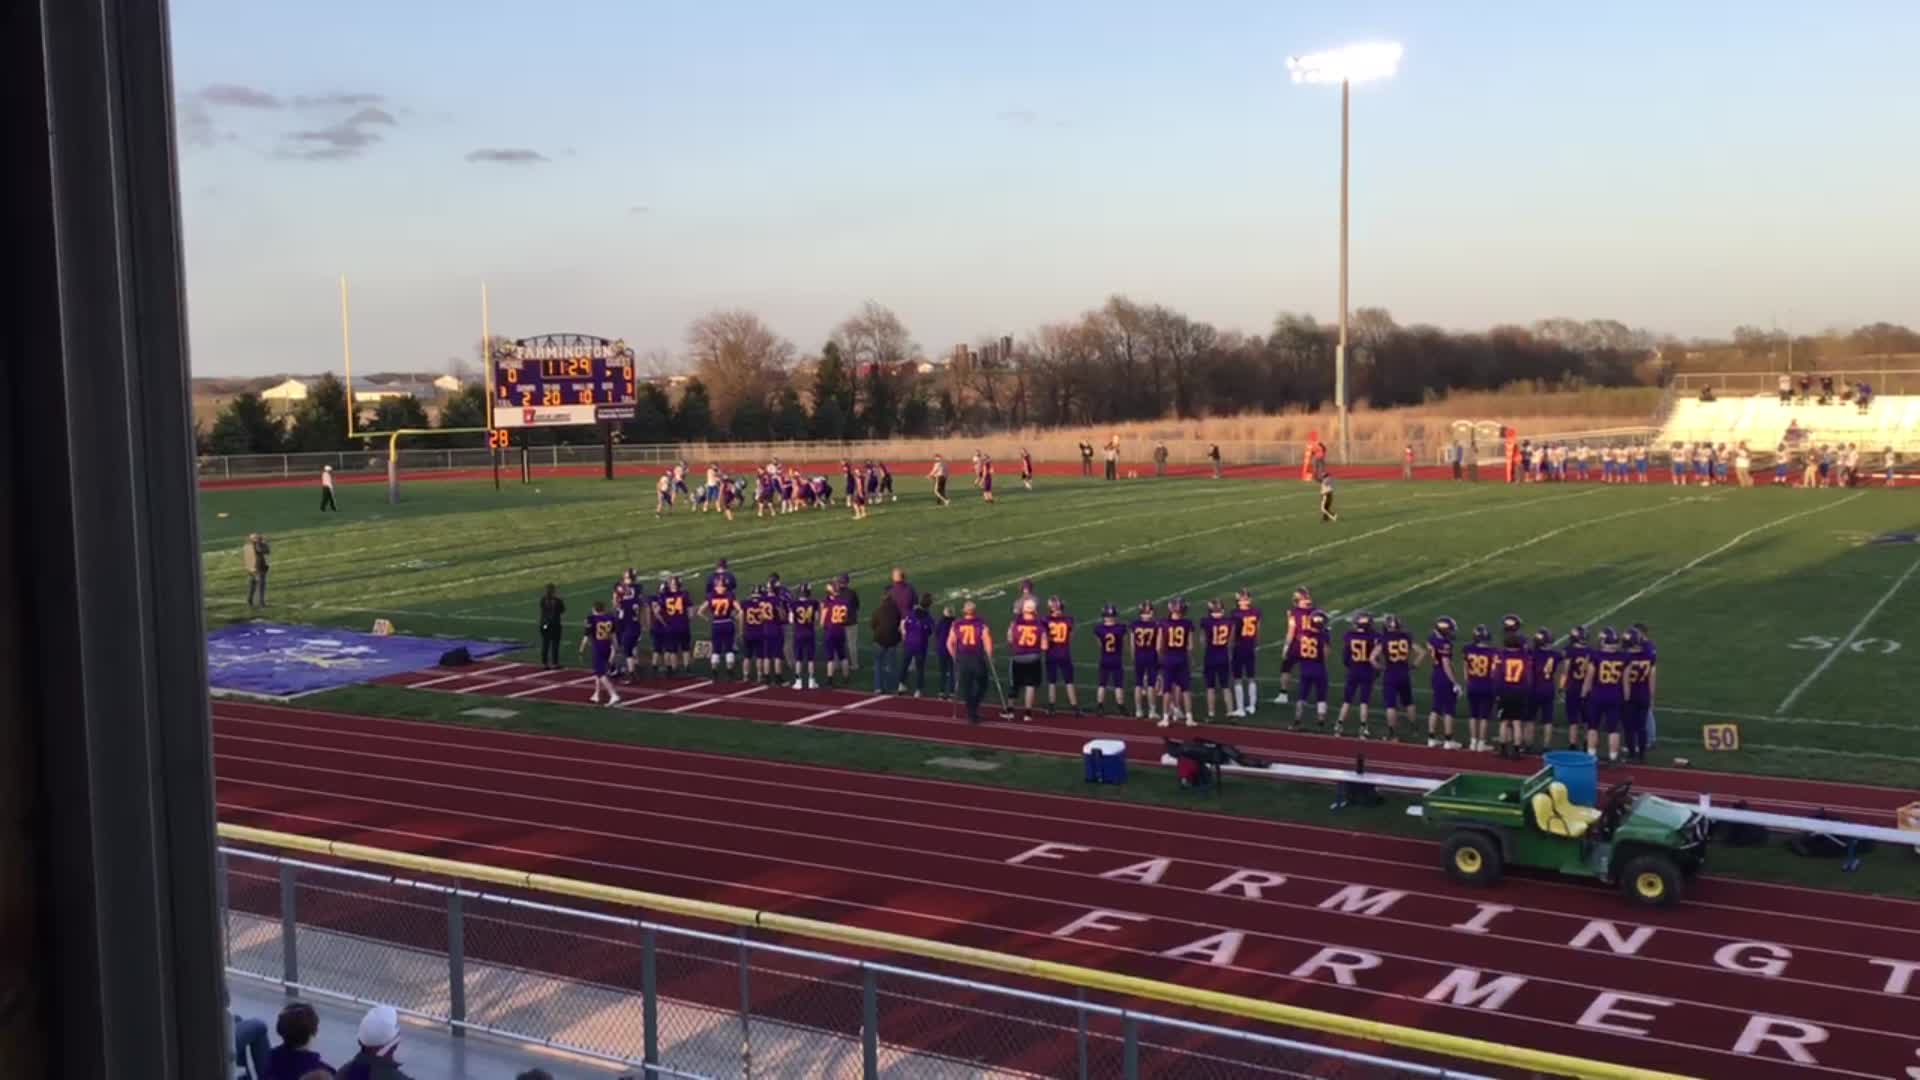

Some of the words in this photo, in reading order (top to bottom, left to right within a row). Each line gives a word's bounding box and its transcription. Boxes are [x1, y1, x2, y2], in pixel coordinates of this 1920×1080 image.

[507, 368, 517, 383] 0
[623, 366, 632, 380] 0
[522, 392, 532, 406] 2
[543, 391, 561, 406] 20
[578, 390, 593, 405] 10
[488, 429, 509, 448] 28
[665, 597, 684, 616] 54
[711, 598, 730, 616] 77
[959, 624, 976, 645] 71
[1017, 625, 1037, 646] 75
[1212, 625, 1229, 645] 12
[1242, 616, 1257, 636] 15
[1104, 633, 1116, 652] 2
[1135, 627, 1154, 647] 37
[1168, 626, 1185, 647] 19
[1351, 638, 1369, 662] 51
[1388, 639, 1409, 661] 59
[1504, 658, 1524, 682] 17
[1599, 660, 1623, 684] 65
[1707, 727, 1735, 748] 50
[1050, 908, 1920, 1080] FARMER
